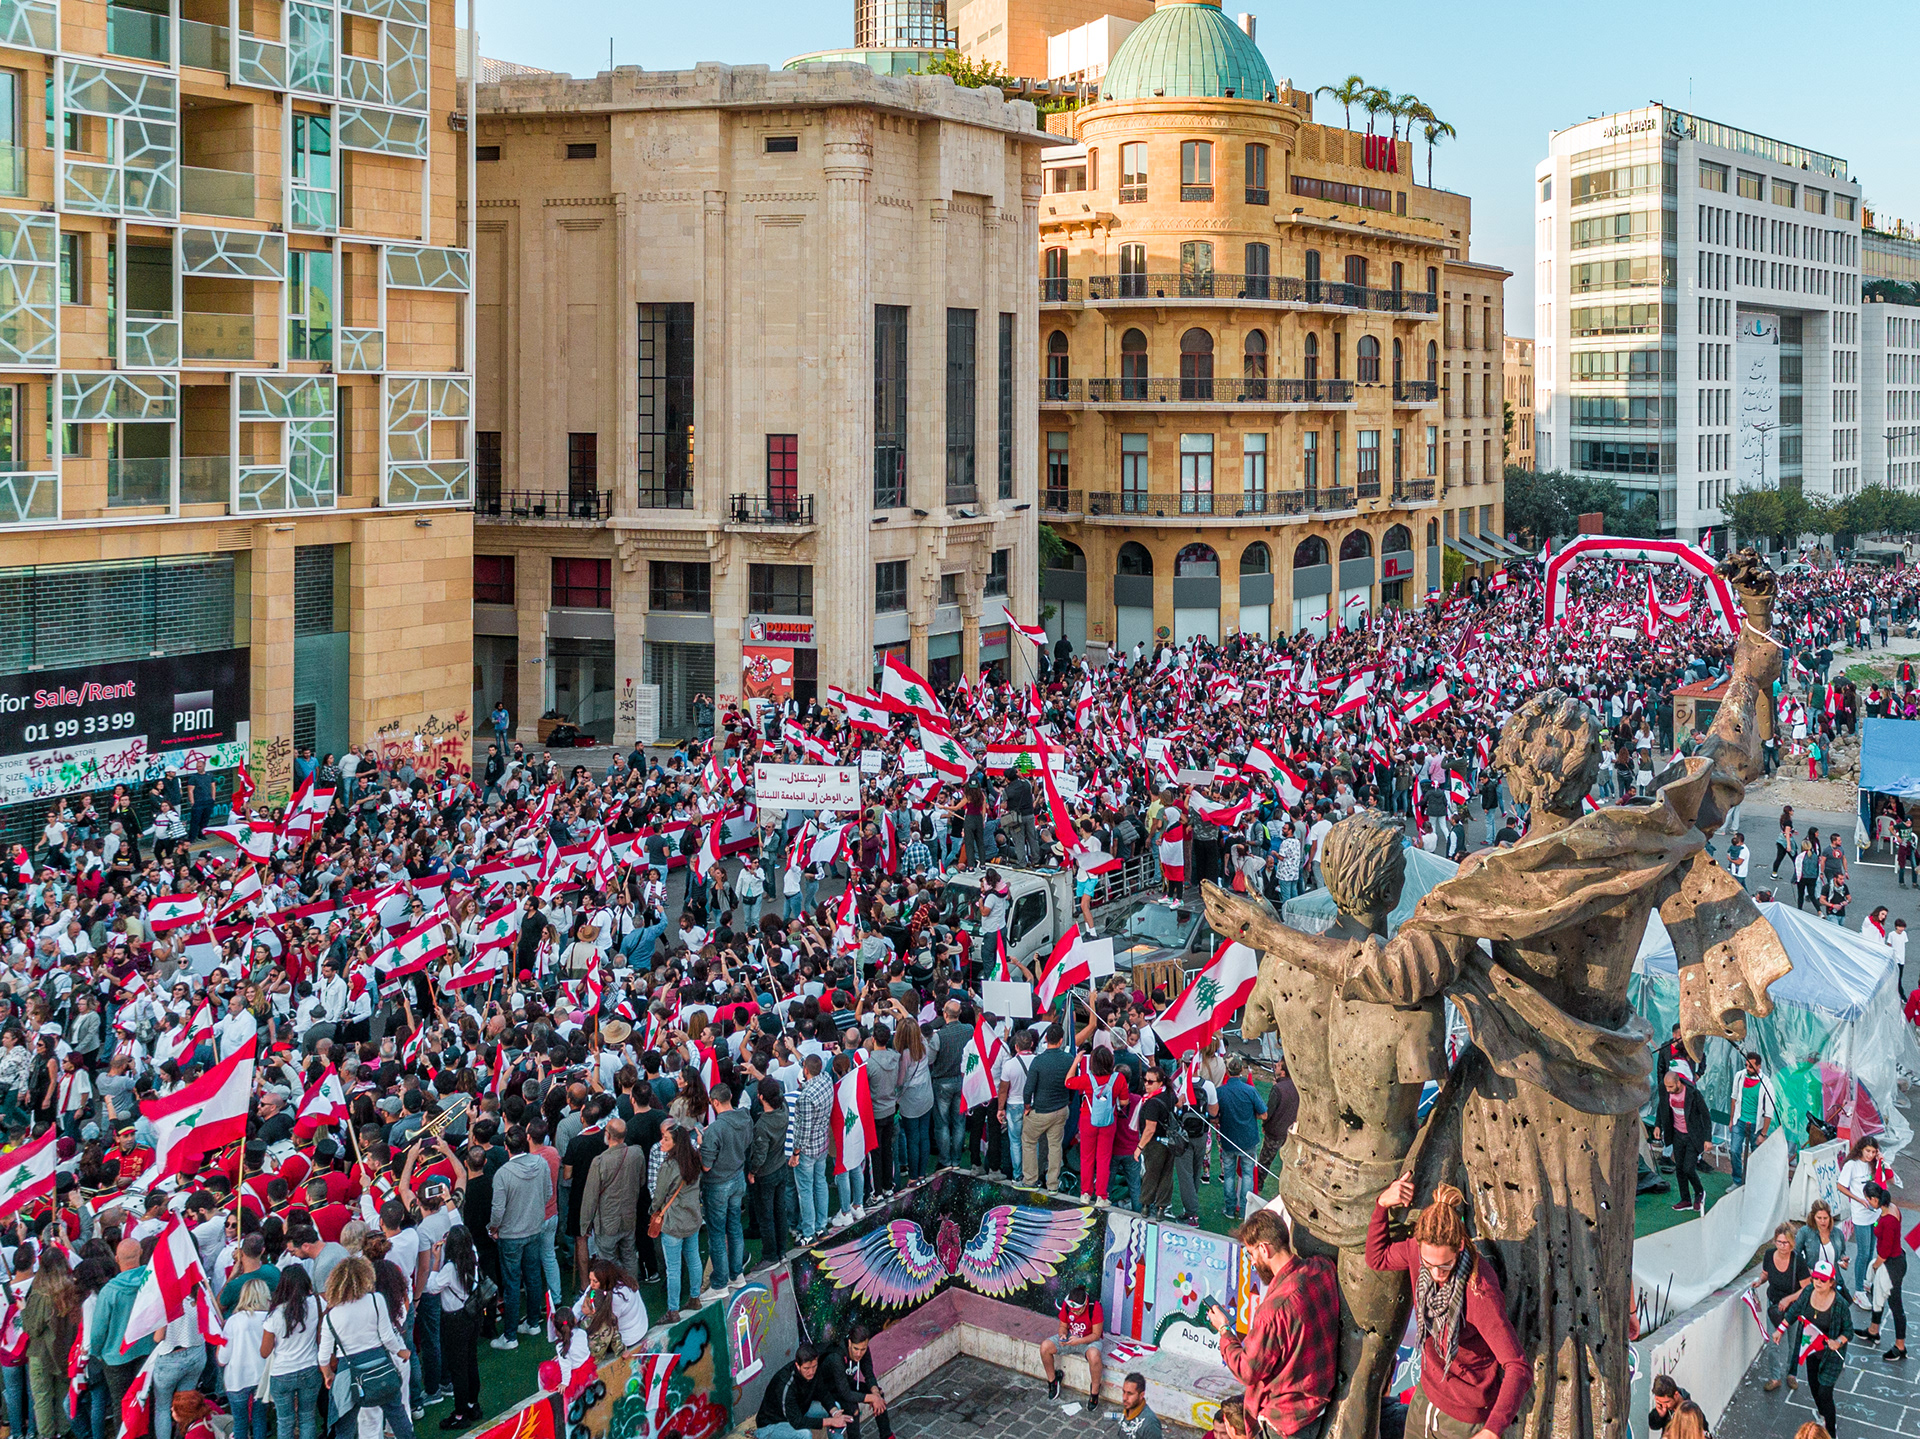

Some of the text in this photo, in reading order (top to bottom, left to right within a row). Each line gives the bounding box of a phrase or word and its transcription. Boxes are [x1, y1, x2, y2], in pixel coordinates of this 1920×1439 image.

[1363, 134, 1398, 173] UFA
[766, 632, 811, 643] DONUTS
[0, 680, 136, 713] for Sale/Rent
[24, 711, 136, 742] 01 99 33 99
[173, 708, 214, 733] PBM
[378, 720, 400, 733] ACAB
[74, 748, 97, 758] STORE
[30, 766, 52, 778] 161
[756, 790, 854, 805] من الوطن إلى الجامعة اللبنانية
[1182, 1328, 1199, 1342] Abo
